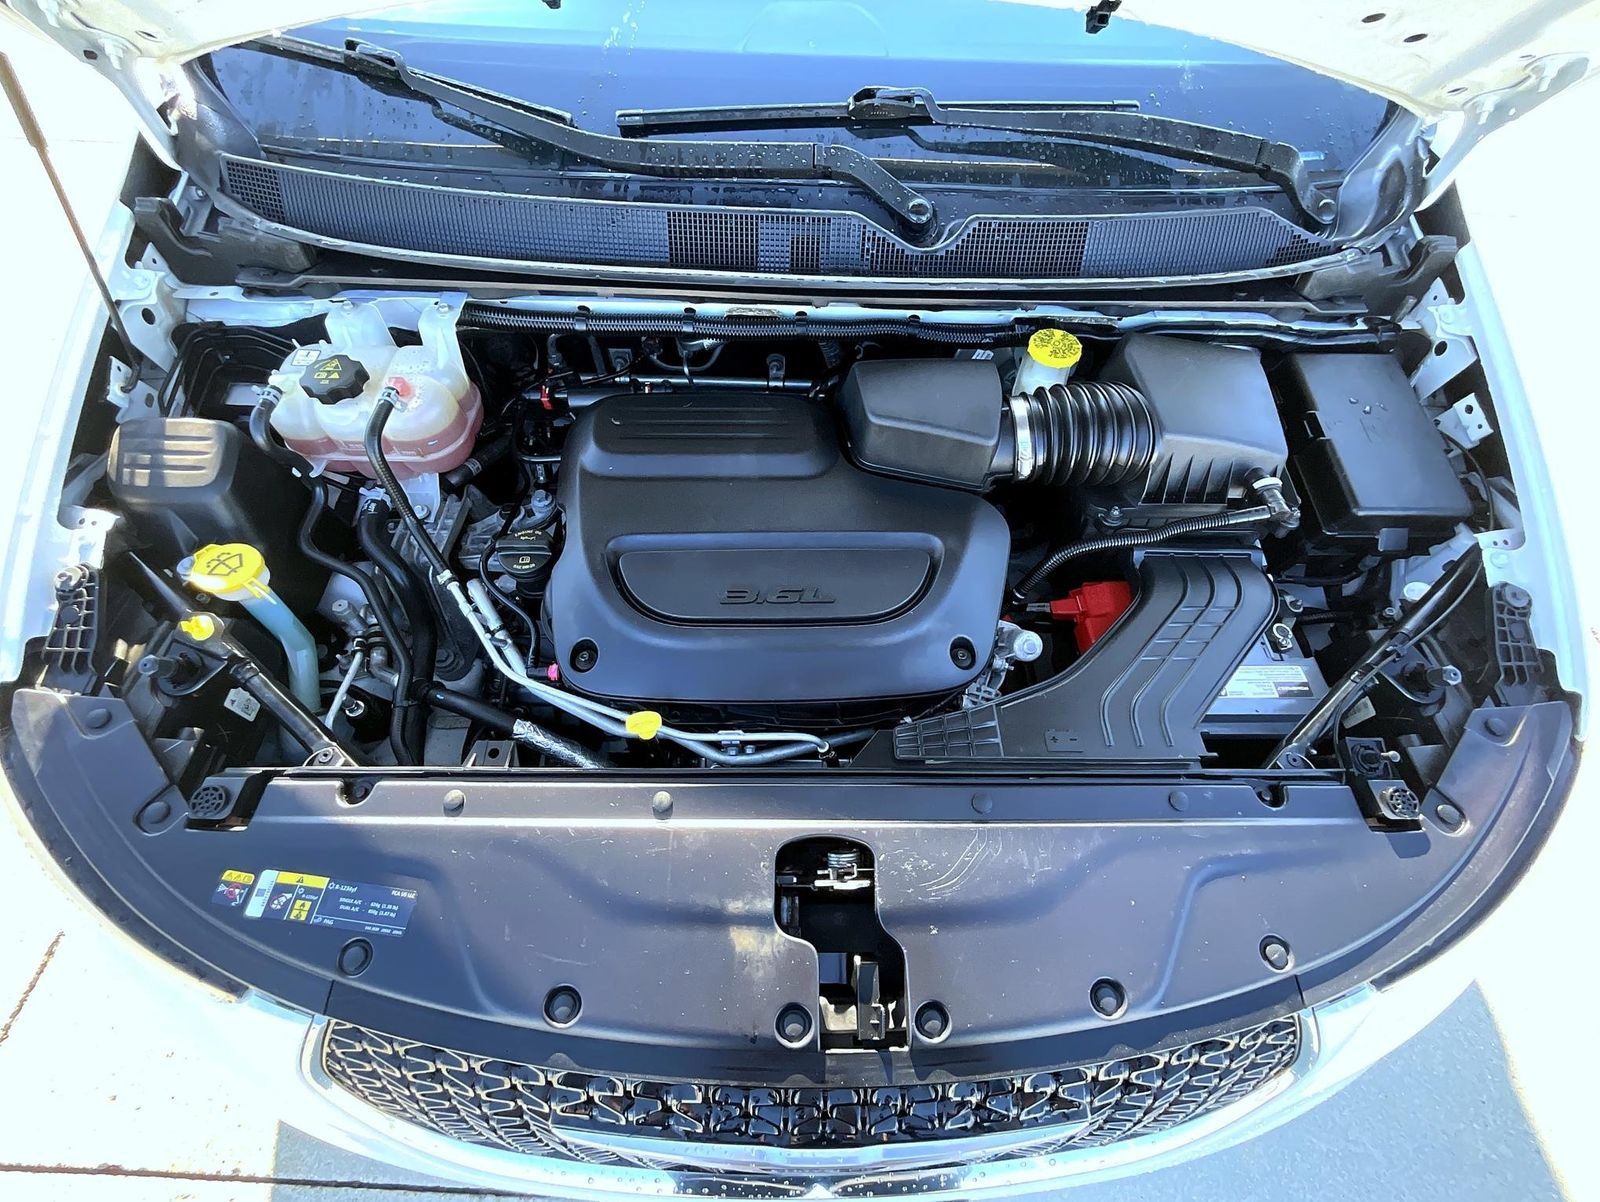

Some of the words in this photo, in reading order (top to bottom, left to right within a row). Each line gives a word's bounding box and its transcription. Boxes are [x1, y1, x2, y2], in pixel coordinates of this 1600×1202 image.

[719, 587, 836, 605] 3.6L
[335, 884, 358, 893] R-1234yf
[407, 891, 416, 899] LLC
